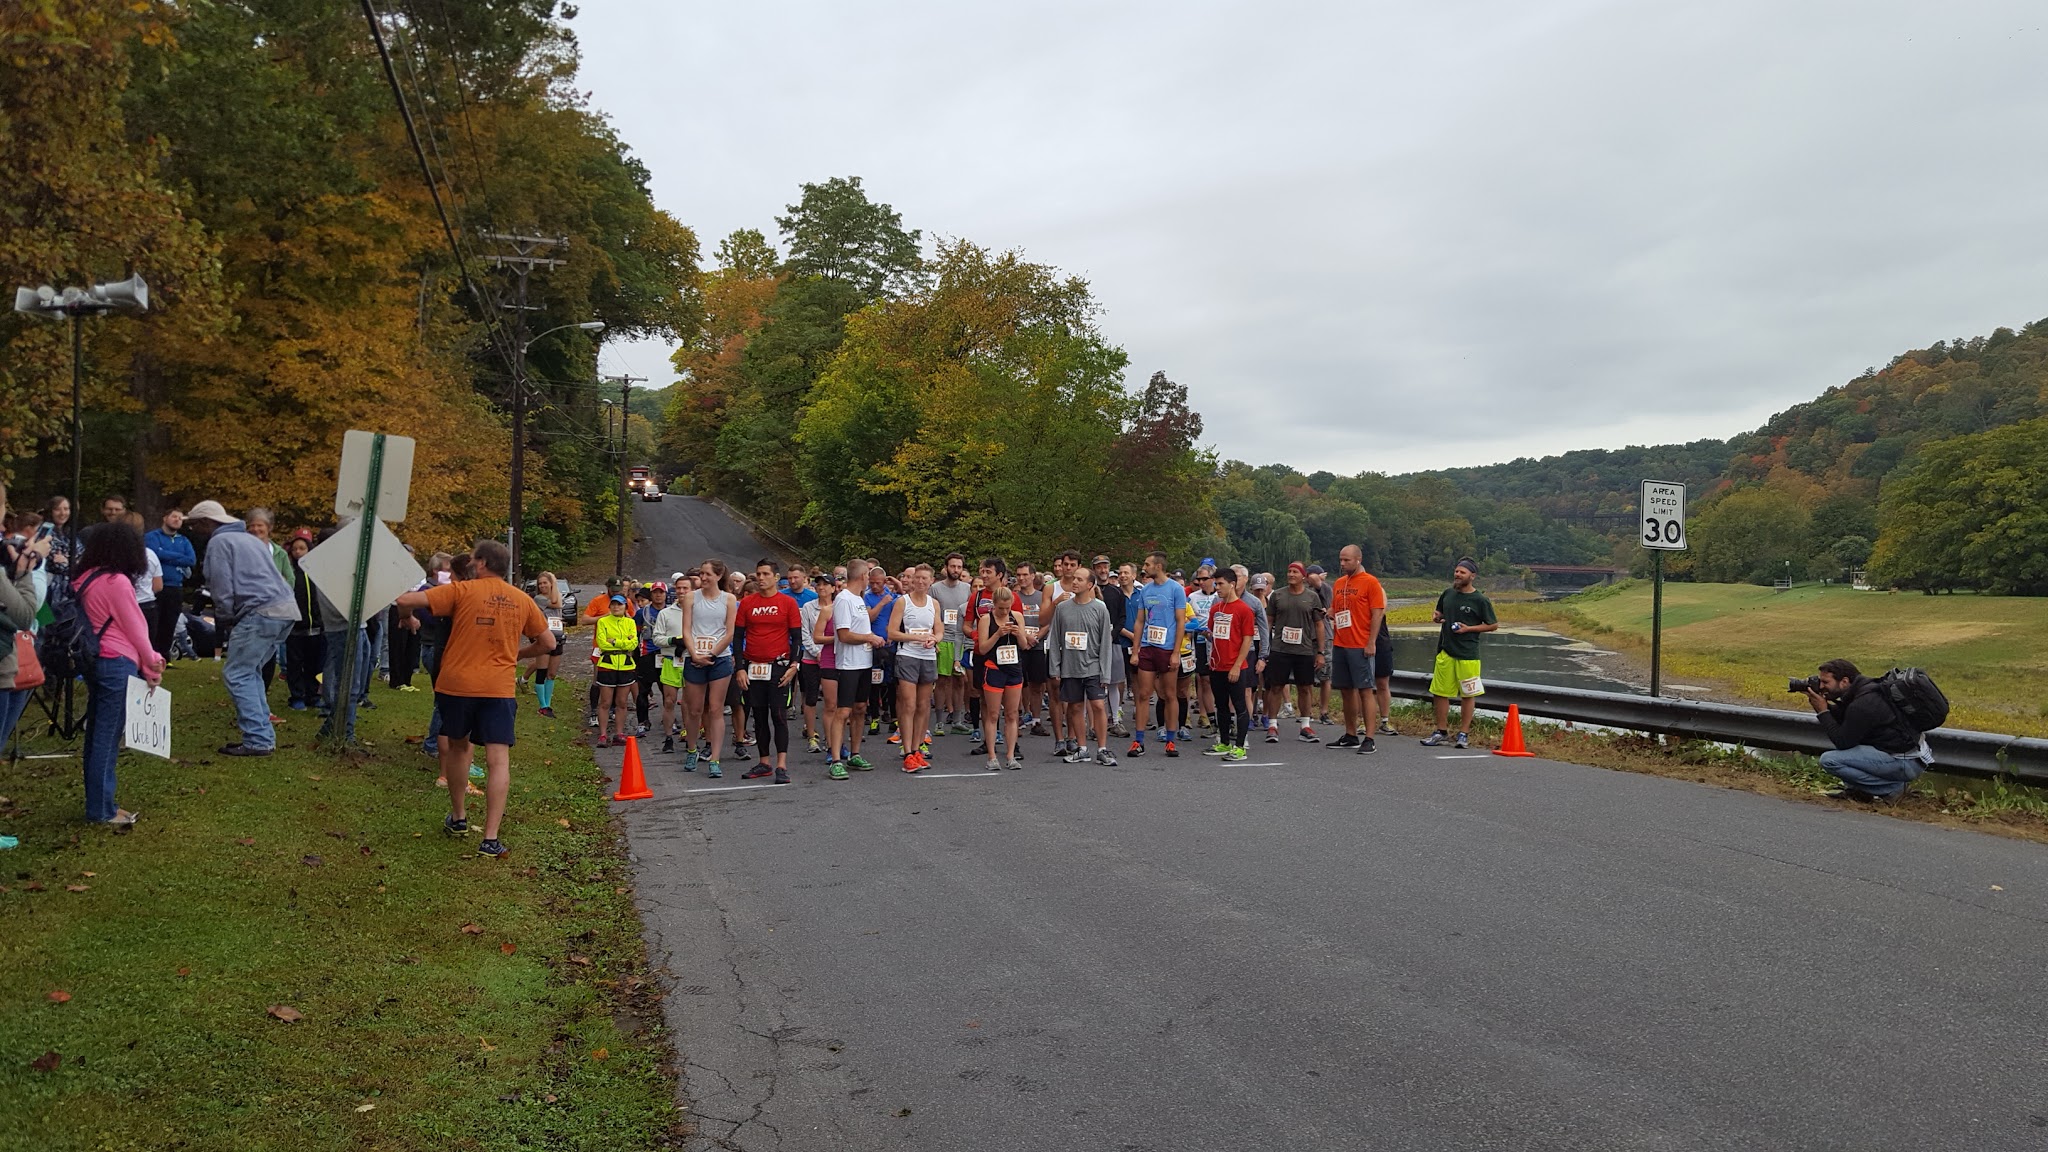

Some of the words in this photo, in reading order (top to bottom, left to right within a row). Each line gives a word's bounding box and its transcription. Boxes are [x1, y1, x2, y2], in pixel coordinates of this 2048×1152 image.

[1652, 487, 1676, 496] AREA
[1650, 496, 1678, 506] SPEED
[1652, 507, 1674, 516] LIMIT
[1643, 517, 1682, 545] 30
[752, 605, 779, 615] NYC
[1149, 630, 1163, 640] 103
[1215, 625, 1227, 635] 143
[1070, 636, 1081, 646] 91
[1284, 631, 1300, 641] 130
[696, 640, 713, 650] 116
[1000, 649, 1015, 660] 133
[752, 665, 768, 676] 101
[1465, 681, 1476, 692] 37
[144, 690, 157, 718] Go
[132, 720, 150, 745] Uncle
